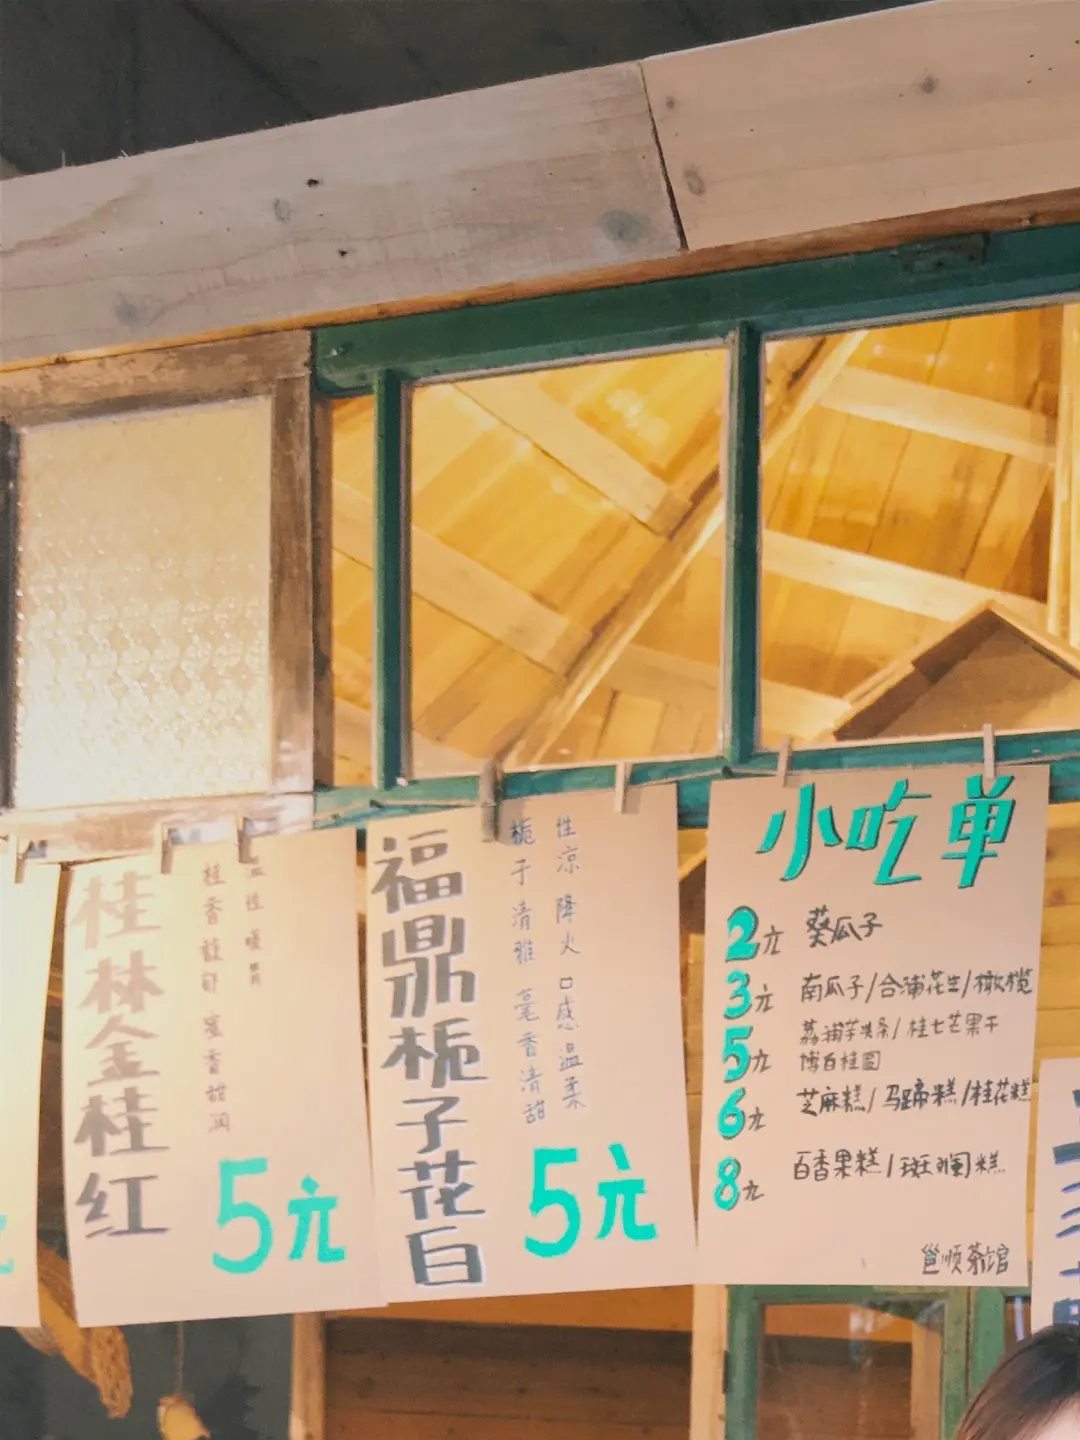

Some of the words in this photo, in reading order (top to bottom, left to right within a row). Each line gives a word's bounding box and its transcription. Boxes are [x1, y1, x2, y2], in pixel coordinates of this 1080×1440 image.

[756, 773, 1016, 889] 小吃单
[725, 905, 785, 963] 2元
[805, 904, 883, 947] 葵瓜子
[723, 970, 774, 1019] 3元
[70, 870, 170, 1240] 桂林金桂红
[371, 827, 488, 1287] 福鼎栀子花白
[722, 1025, 773, 1083] 5元
[716, 1087, 767, 1140] 6元
[211, 1157, 346, 1275] 5元
[523, 1143, 658, 1259] 5元
[712, 1155, 765, 1212] 8元
